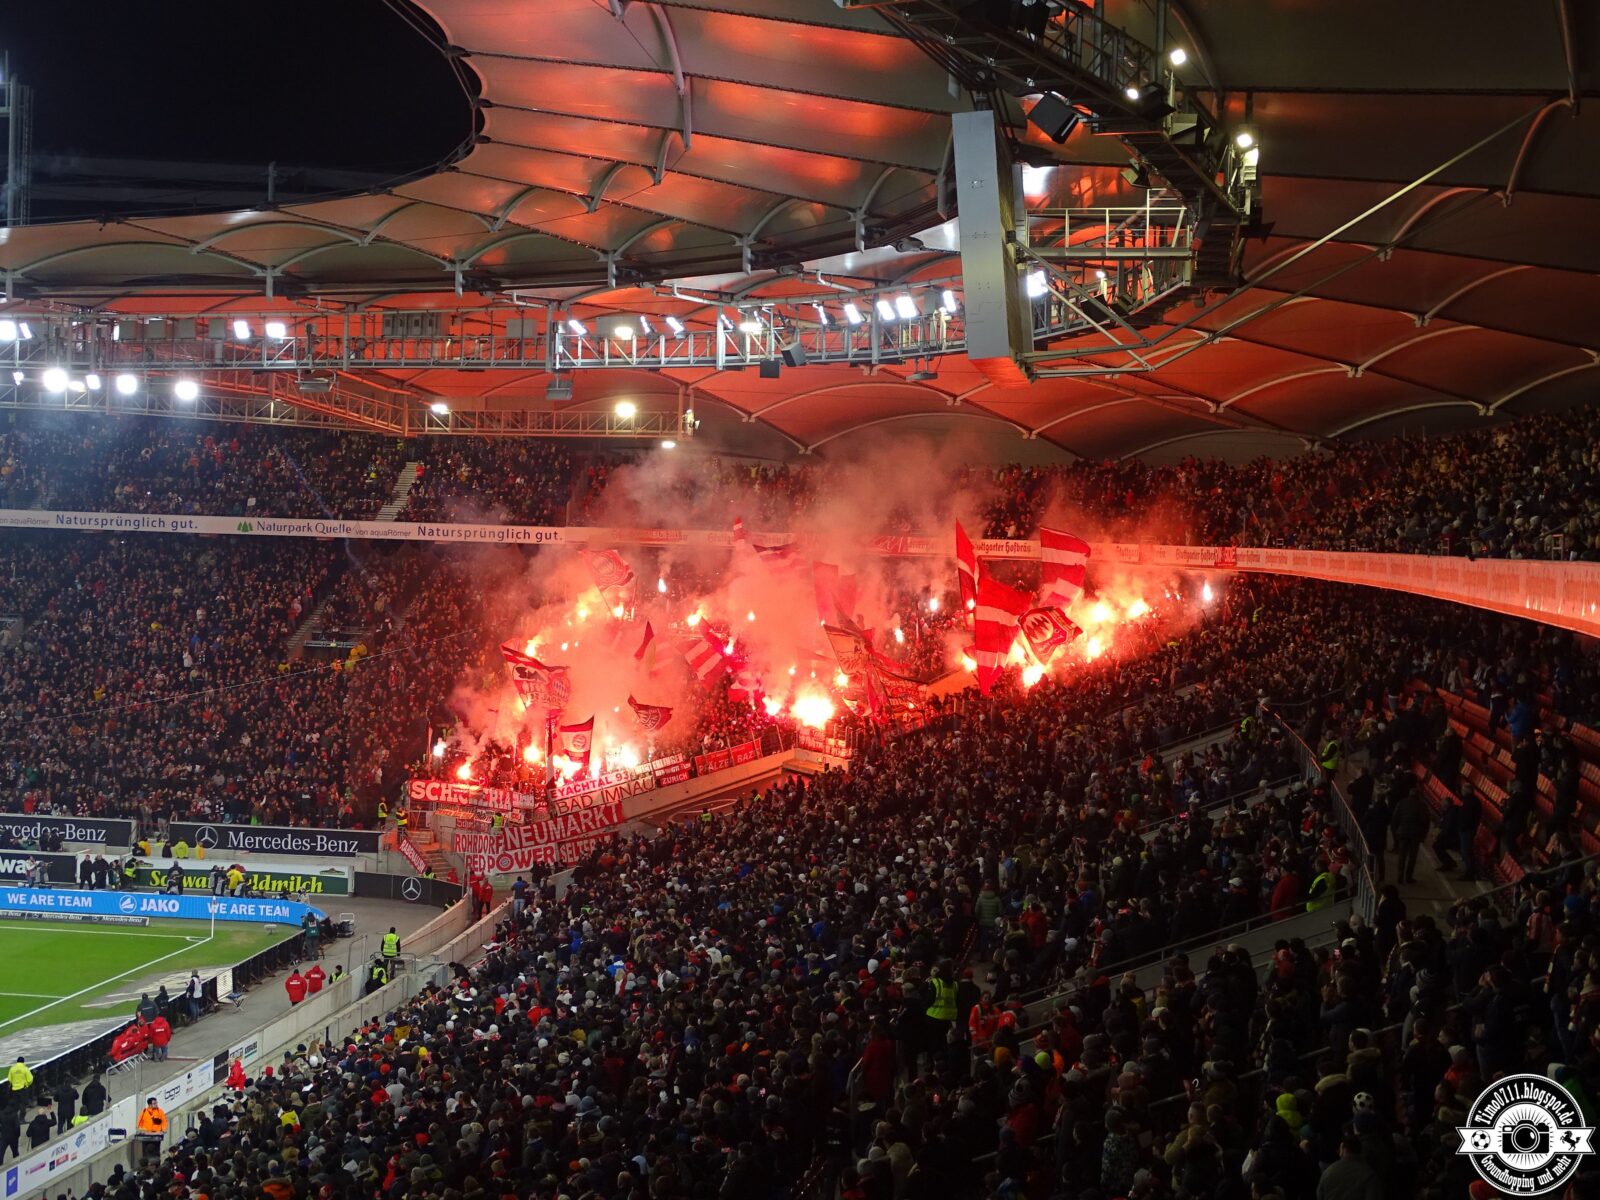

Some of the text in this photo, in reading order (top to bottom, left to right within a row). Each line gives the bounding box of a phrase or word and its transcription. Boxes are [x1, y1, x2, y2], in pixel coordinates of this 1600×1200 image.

[56, 514, 198, 530] Natursprünglich gut.
[257, 521, 351, 535] Naturpark Quelle
[417, 526, 563, 543] Natursprünglich gut.
[550, 770, 629, 799] EYACHTAL 93
[556, 795, 594, 815] BAD
[601, 775, 654, 804] IMNAU
[505, 804, 620, 850] NEUMARKT
[227, 831, 359, 853] Mercedes-Benz
[455, 833, 502, 855] ROHRDORF
[465, 855, 486, 873] RED
[7, 893, 92, 908] WE ARE TEAM
[140, 899, 179, 913] JAKO
[207, 902, 289, 918] WE ARE TEAM
